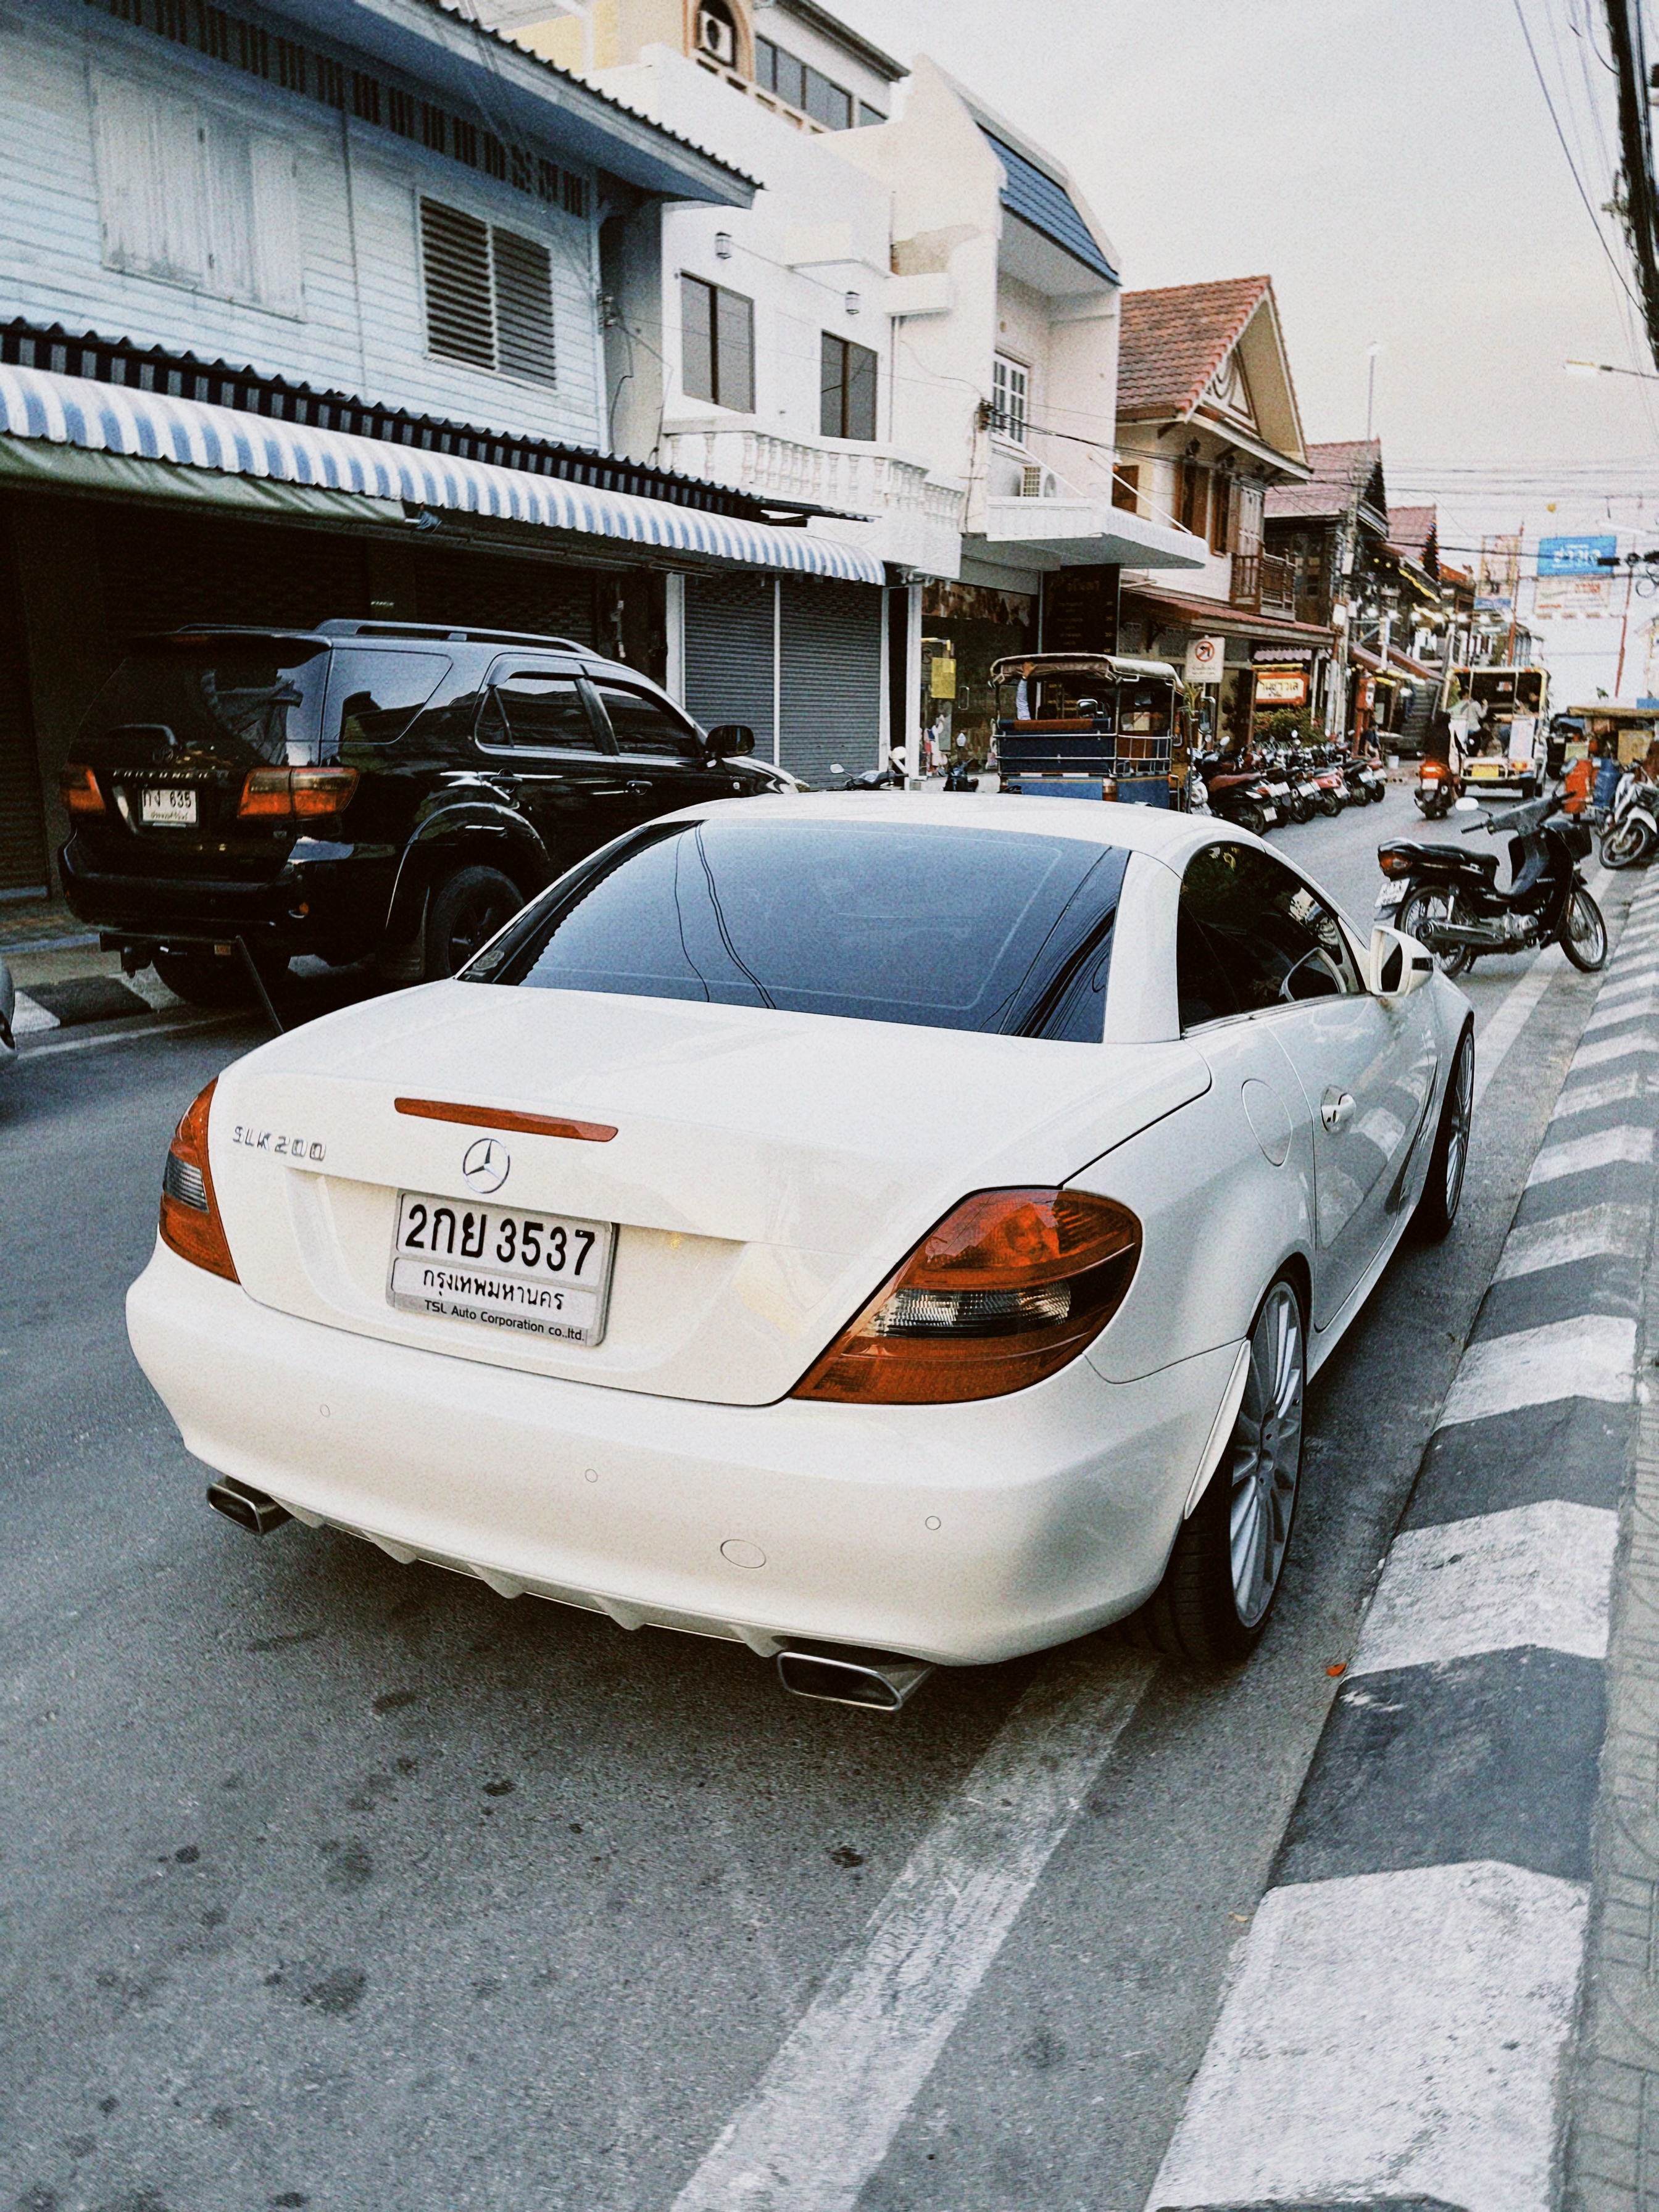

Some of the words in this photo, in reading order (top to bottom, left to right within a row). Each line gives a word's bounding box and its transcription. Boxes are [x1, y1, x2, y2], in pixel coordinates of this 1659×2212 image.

[496, 1218, 596, 1276] 3537
[423, 1269, 565, 1310] กรุงเทพมหานคร
[425, 1299, 447, 1314] TSL
[451, 1305, 476, 1320] Auto
[481, 1312, 544, 1333] Corporation
